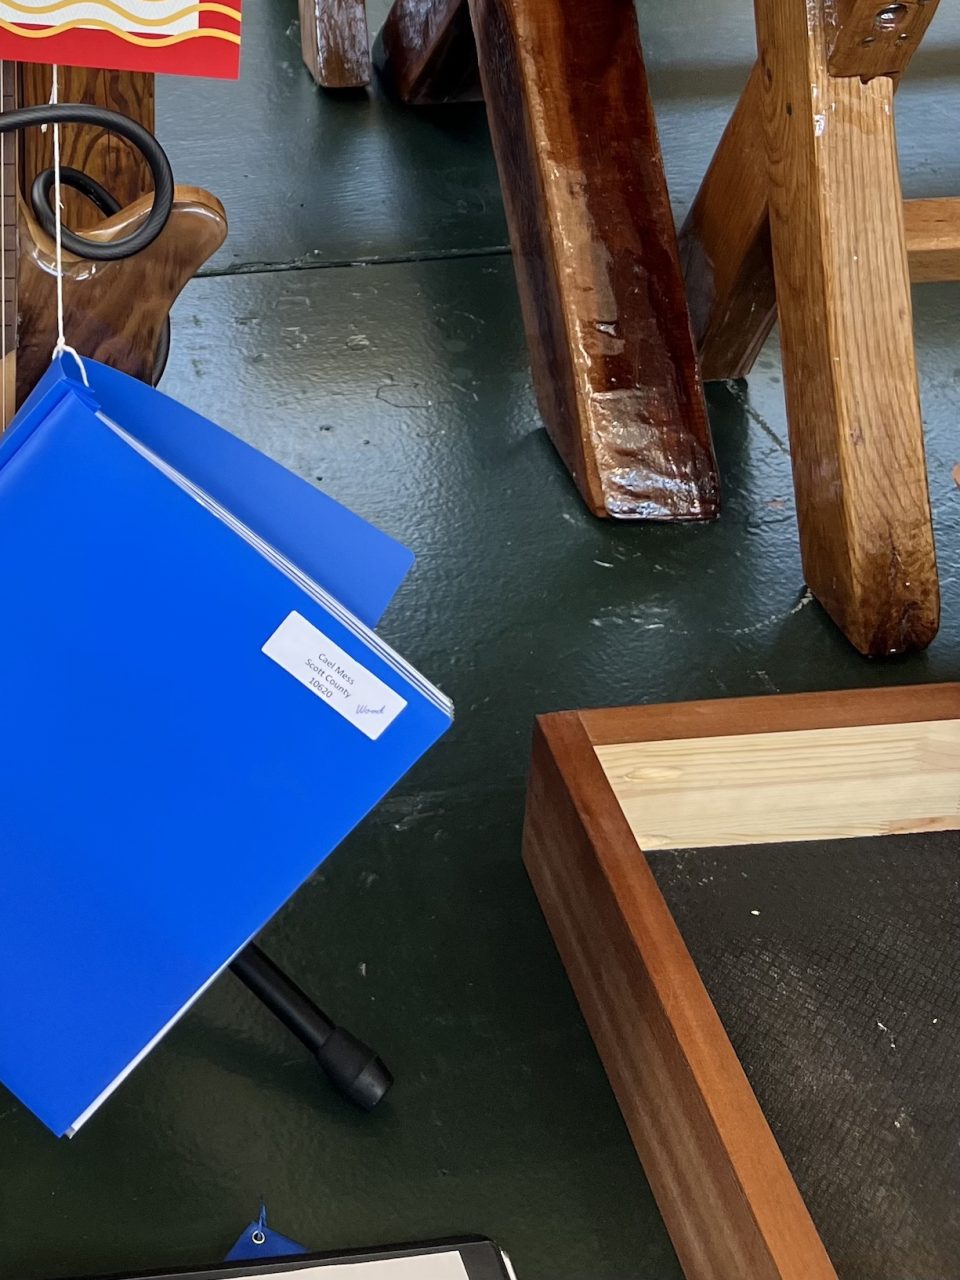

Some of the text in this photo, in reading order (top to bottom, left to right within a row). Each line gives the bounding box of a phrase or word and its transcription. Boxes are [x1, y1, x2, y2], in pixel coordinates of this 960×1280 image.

[305, 658, 351, 698] Scott County
[318, 653, 355, 685] Cael Mess
[308, 677, 334, 698] 10620
